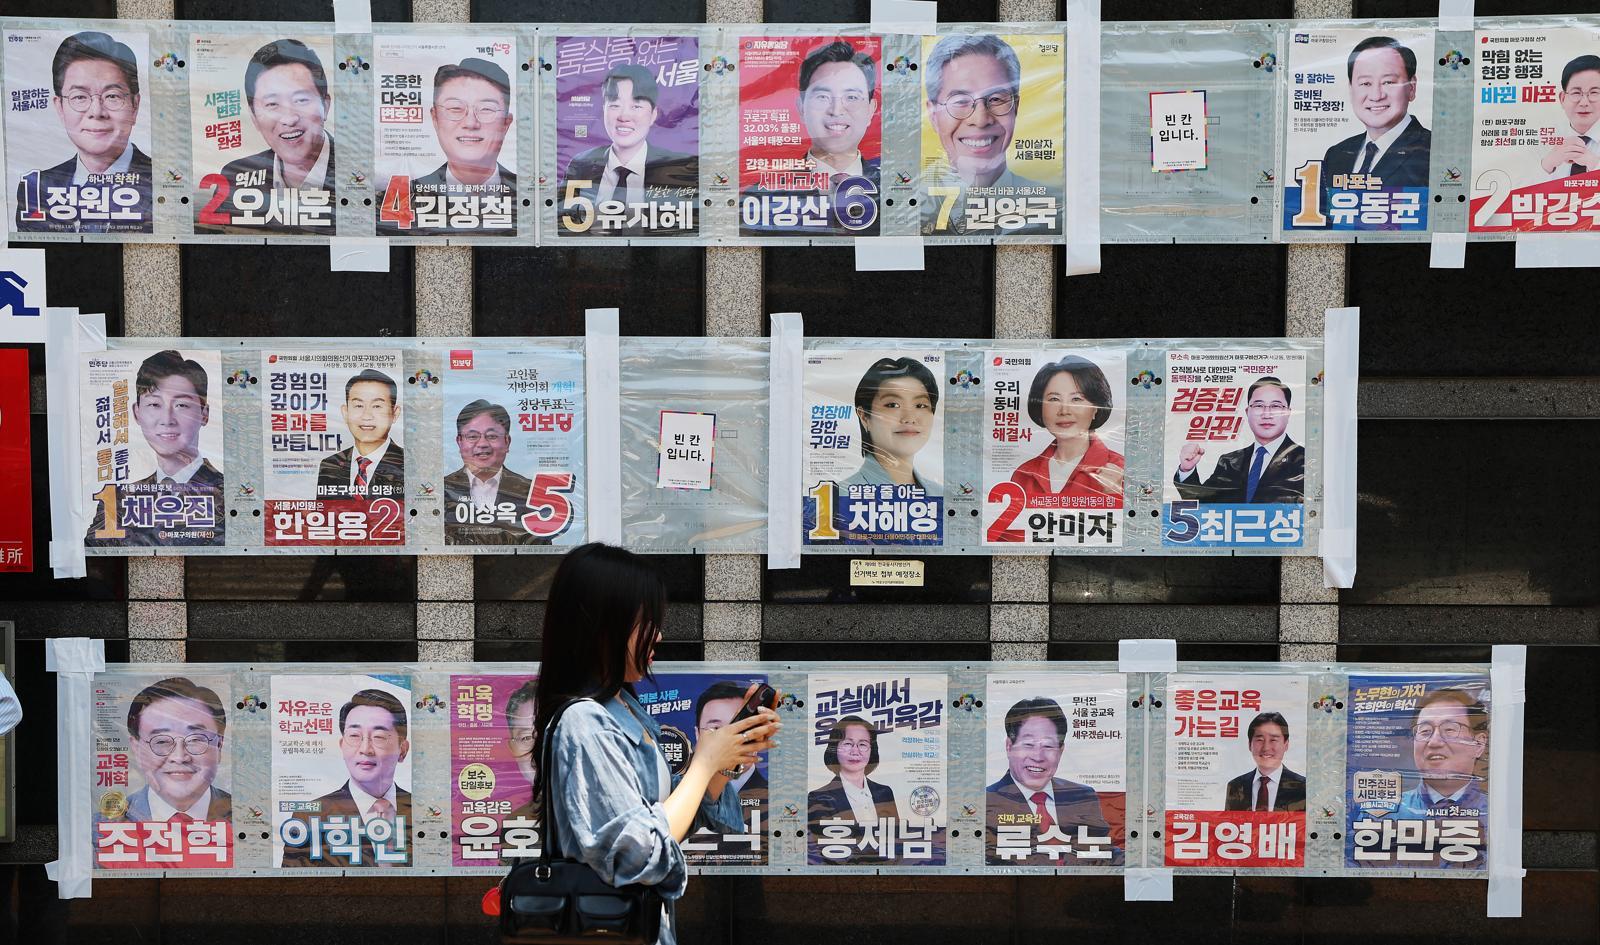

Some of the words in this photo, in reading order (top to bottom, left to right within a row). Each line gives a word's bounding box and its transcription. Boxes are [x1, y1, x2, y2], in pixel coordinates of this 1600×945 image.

[1038, 44, 1058, 53] 정의당
[1482, 49, 1510, 64] 막힘
[1514, 49, 1543, 64] 없는
[656, 58, 699, 87] 서울
[1294, 73, 1304, 84] 일
[1306, 73, 1335, 84] 잘하는
[1481, 65, 1511, 80] 현장
[1514, 65, 1543, 80] 행정
[381, 75, 422, 89] 조용한
[204, 89, 241, 108] 시작된
[381, 91, 422, 106] 다수의
[1293, 89, 1322, 100] 준비된
[12, 98, 48, 112] 서울시장
[1293, 101, 1345, 112] 마포구청장!
[1165, 114, 1176, 126] 빈
[1180, 114, 1192, 126] 칸
[204, 120, 242, 138] 압도적
[743, 124, 779, 133] 32.03%
[1159, 129, 1199, 141] 입니다.
[1509, 128, 1524, 137] 힘이
[743, 136, 767, 146] 서울의
[767, 136, 802, 146] 태풍으로!
[1014, 139, 1053, 150] 같이살자
[1494, 138, 1517, 146] 최선을
[1526, 138, 1539, 146] 하는
[1540, 136, 1565, 146] 구청장
[1014, 150, 1056, 161] 서울혁명!
[745, 159, 770, 170] 강한
[771, 159, 818, 170] 미래보수
[88, 174, 113, 184] 하나씩
[114, 173, 140, 185] 착착!
[235, 169, 267, 188] 역시!
[759, 172, 829, 191] 세대교체
[1332, 173, 1383, 191] 마포는
[20, 169, 47, 221] 1
[46, 186, 142, 221] 정원오
[415, 184, 437, 193] 당신의
[439, 184, 447, 193] 한
[448, 184, 463, 193] 표를
[465, 184, 486, 193] 끝까지
[488, 184, 511, 193] 지키는
[966, 187, 997, 196] 뿌리부터
[998, 187, 1014, 196] 바꿀
[1016, 187, 1047, 196] 서울시장
[1292, 160, 1327, 228] 1
[1330, 192, 1421, 224] 유동균
[199, 173, 231, 225] 2
[231, 187, 332, 226] 오세훈
[380, 175, 416, 230] 4
[415, 195, 512, 229] 김정철
[562, 179, 595, 233] 5
[596, 200, 694, 230] 유지혜
[743, 195, 830, 227] 이강산
[834, 175, 878, 231] 6
[928, 186, 961, 231] 7
[964, 197, 1058, 231] 권영국
[89, 360, 109, 368] 민주당
[452, 359, 471, 368] 진보당
[1004, 358, 1031, 366] 국민의힘
[507, 369, 539, 381] 고인물
[1208, 366, 1237, 374] 대한민국
[270, 372, 328, 391] 경험의
[1203, 375, 1234, 383] 수훈받은
[507, 381, 549, 393] 지방의회
[993, 380, 1020, 396] 우리
[270, 393, 328, 411] 깊이가
[517, 398, 576, 412] 정당투표는
[993, 397, 1020, 411] 동네
[1170, 387, 1244, 413] 검증된
[811, 405, 851, 420] 현장에
[993, 412, 1019, 426] 민원
[96, 396, 111, 446] 젊어서
[271, 413, 328, 432] 결과를
[517, 413, 574, 432] 진보당
[810, 420, 838, 435] 강한
[1185, 416, 1244, 441] 일꾼!
[674, 433, 685, 446] 빈
[689, 434, 701, 447] 칸
[992, 427, 1032, 442] 해결사
[272, 433, 343, 453] 만듭니다
[810, 435, 850, 450] 구의원
[666, 448, 705, 462] 입니다.
[97, 447, 113, 482] 좋다
[121, 484, 173, 493] 서울시의원후보
[848, 485, 876, 500] 일할
[880, 485, 893, 500] 줄
[898, 485, 925, 500] 아는
[273, 501, 325, 512] 서울시의원은
[1031, 496, 1060, 507] 서교동의
[1062, 497, 1071, 507] 힘!
[1072, 497, 1105, 507] 망원1동의
[1106, 497, 1116, 507] 힘!
[92, 483, 127, 540] 1
[121, 495, 217, 529] 채우진
[808, 480, 840, 540] 1
[848, 501, 938, 532] 차해영
[986, 481, 1028, 543] 2
[1028, 511, 1118, 543] 안미자
[272, 511, 368, 541] 한일용
[368, 497, 402, 542] 2
[1166, 499, 1201, 544] 5
[1200, 509, 1301, 543] 최근성
[896, 570, 921, 578] 예정장소
[457, 684, 493, 703] 교육
[815, 678, 911, 718] 교실에서
[1174, 689, 1262, 712] 좋은교육
[279, 700, 333, 717] 자유로운
[1072, 697, 1097, 706] 무너진
[457, 703, 493, 722] 혁명
[1072, 708, 1089, 717] 서울
[1090, 708, 1115, 717] 공교육
[279, 718, 333, 735] 학교선택
[1072, 719, 1097, 728] 올바로
[1174, 716, 1239, 738] 가는길
[1072, 730, 1123, 740] 세우겠습니다.
[97, 753, 129, 770] 교육
[96, 771, 129, 787] 개혁
[467, 770, 487, 780] 보수
[461, 781, 493, 790] 단일후보
[1358, 779, 1397, 789] 민주진보
[1358, 790, 1397, 800] 시민후보
[461, 801, 512, 815] 교육감은
[1449, 806, 1460, 816] 첫
[997, 814, 1016, 824] 진짜
[1016, 813, 1043, 824] 교육감
[98, 821, 228, 862] 조전혁
[279, 815, 408, 864] 이학인
[817, 817, 939, 859] 홍제남
[995, 825, 1113, 860] 류수노
[1173, 821, 1296, 860] 김영배
[1352, 819, 1481, 862] 한만중
